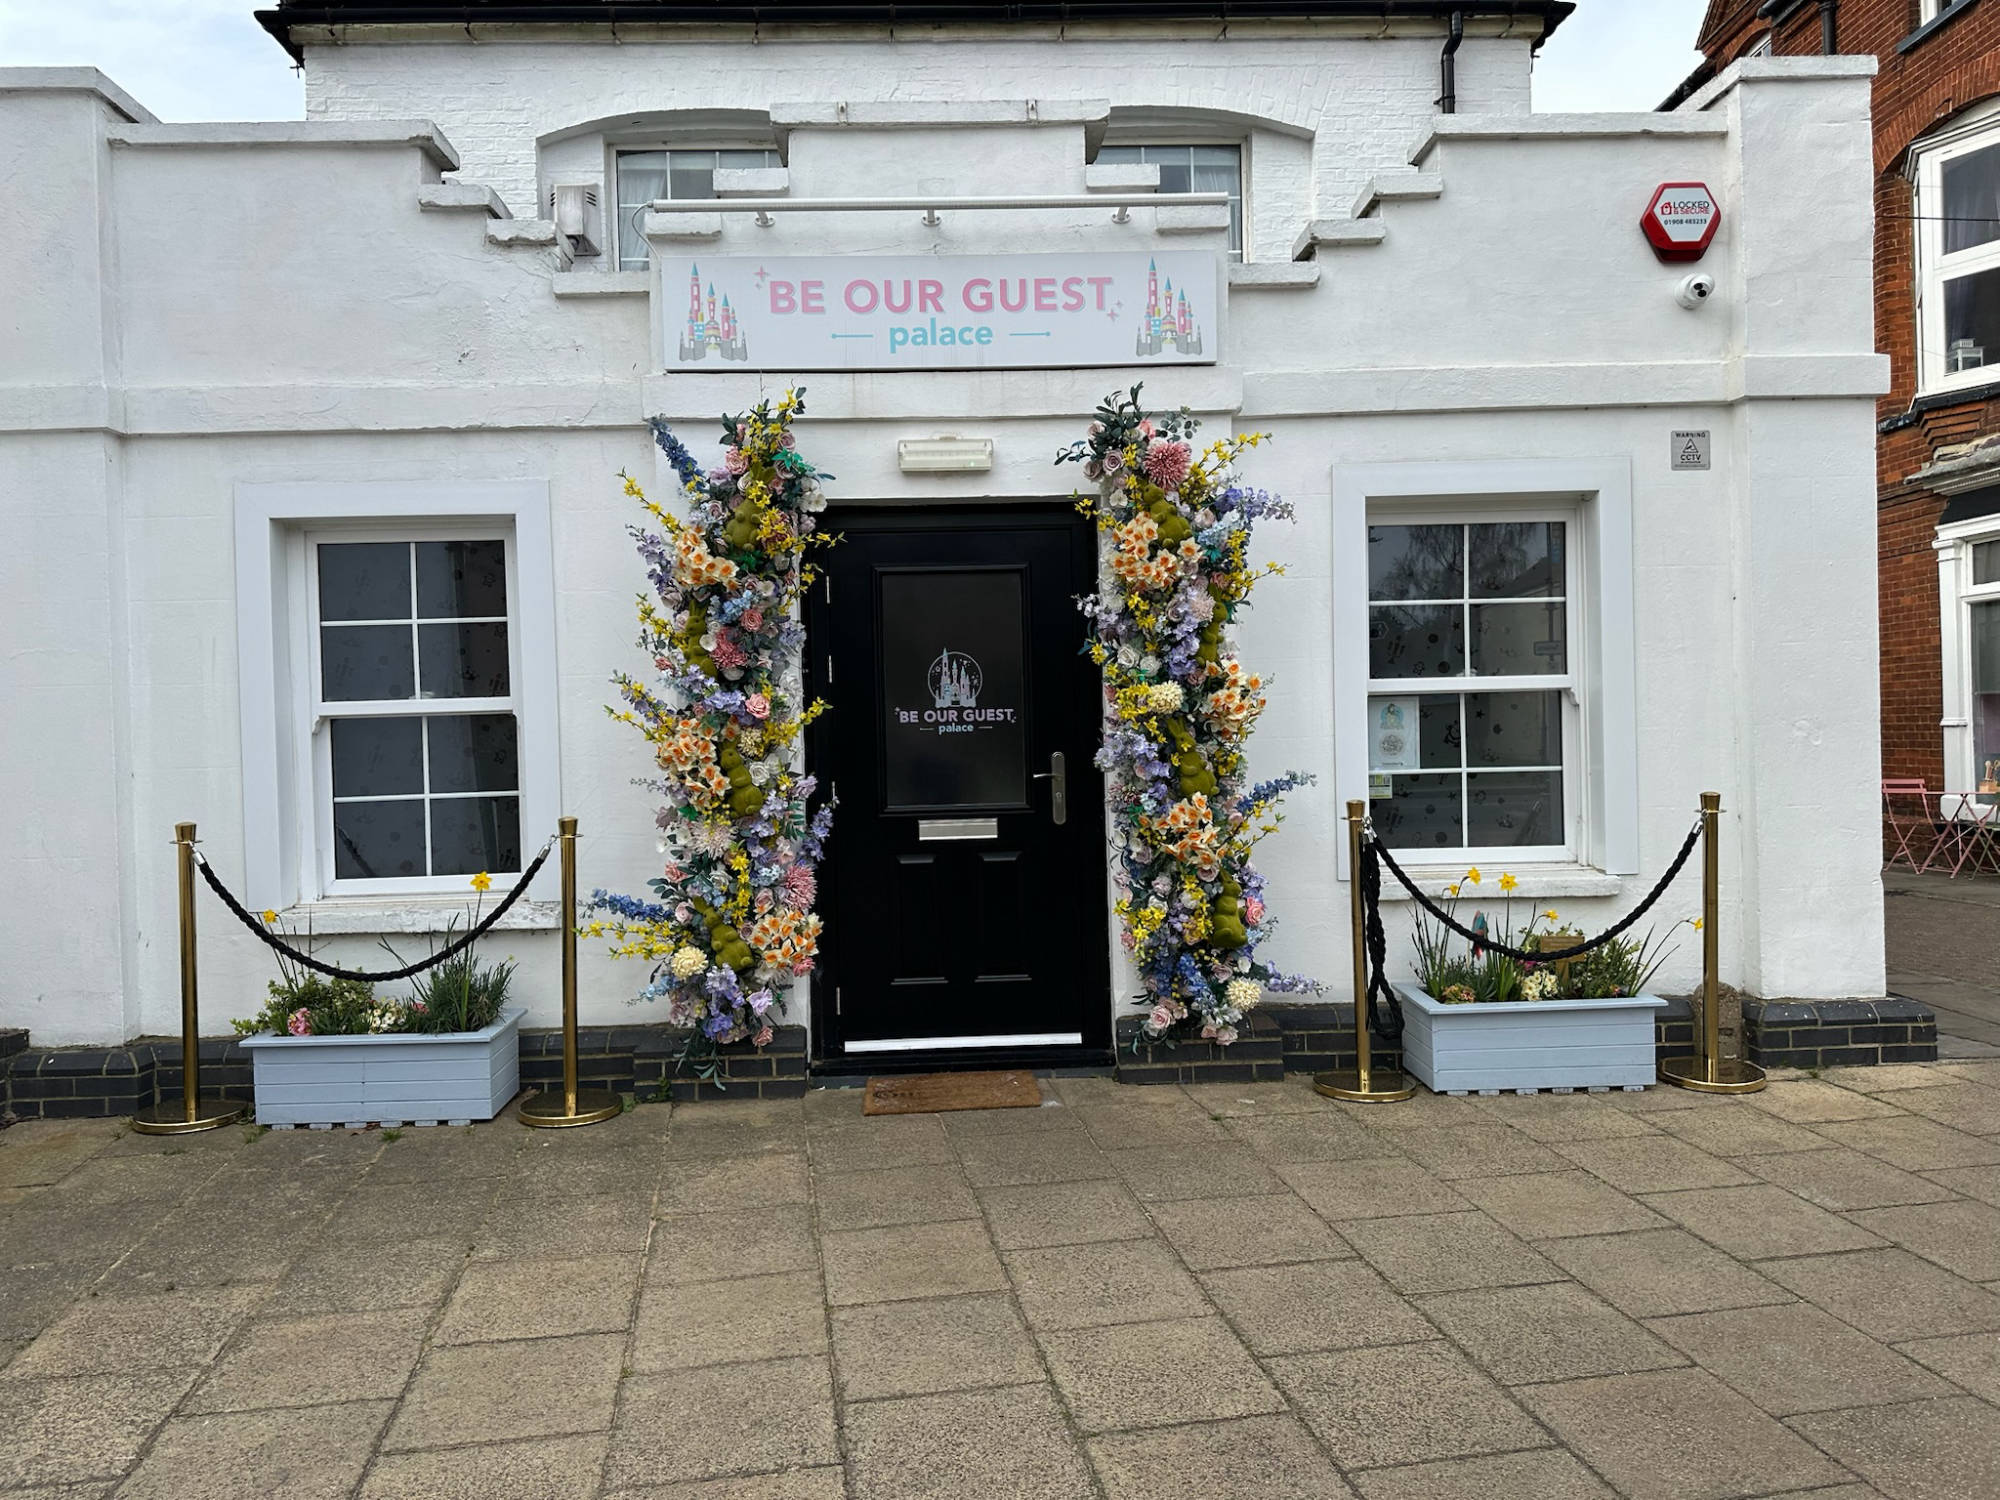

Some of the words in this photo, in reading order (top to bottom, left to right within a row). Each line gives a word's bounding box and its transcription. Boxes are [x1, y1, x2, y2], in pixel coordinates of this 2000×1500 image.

[1673, 201, 1710, 209] LOCKED
[770, 280, 825, 314] BE
[844, 279, 945, 314] OUR
[962, 277, 1113, 313] GUEST
[889, 317, 993, 354] palace
[900, 710, 919, 723] BE
[923, 709, 959, 723] OUR
[962, 708, 1014, 721] GUEST
[938, 722, 974, 735] palace
